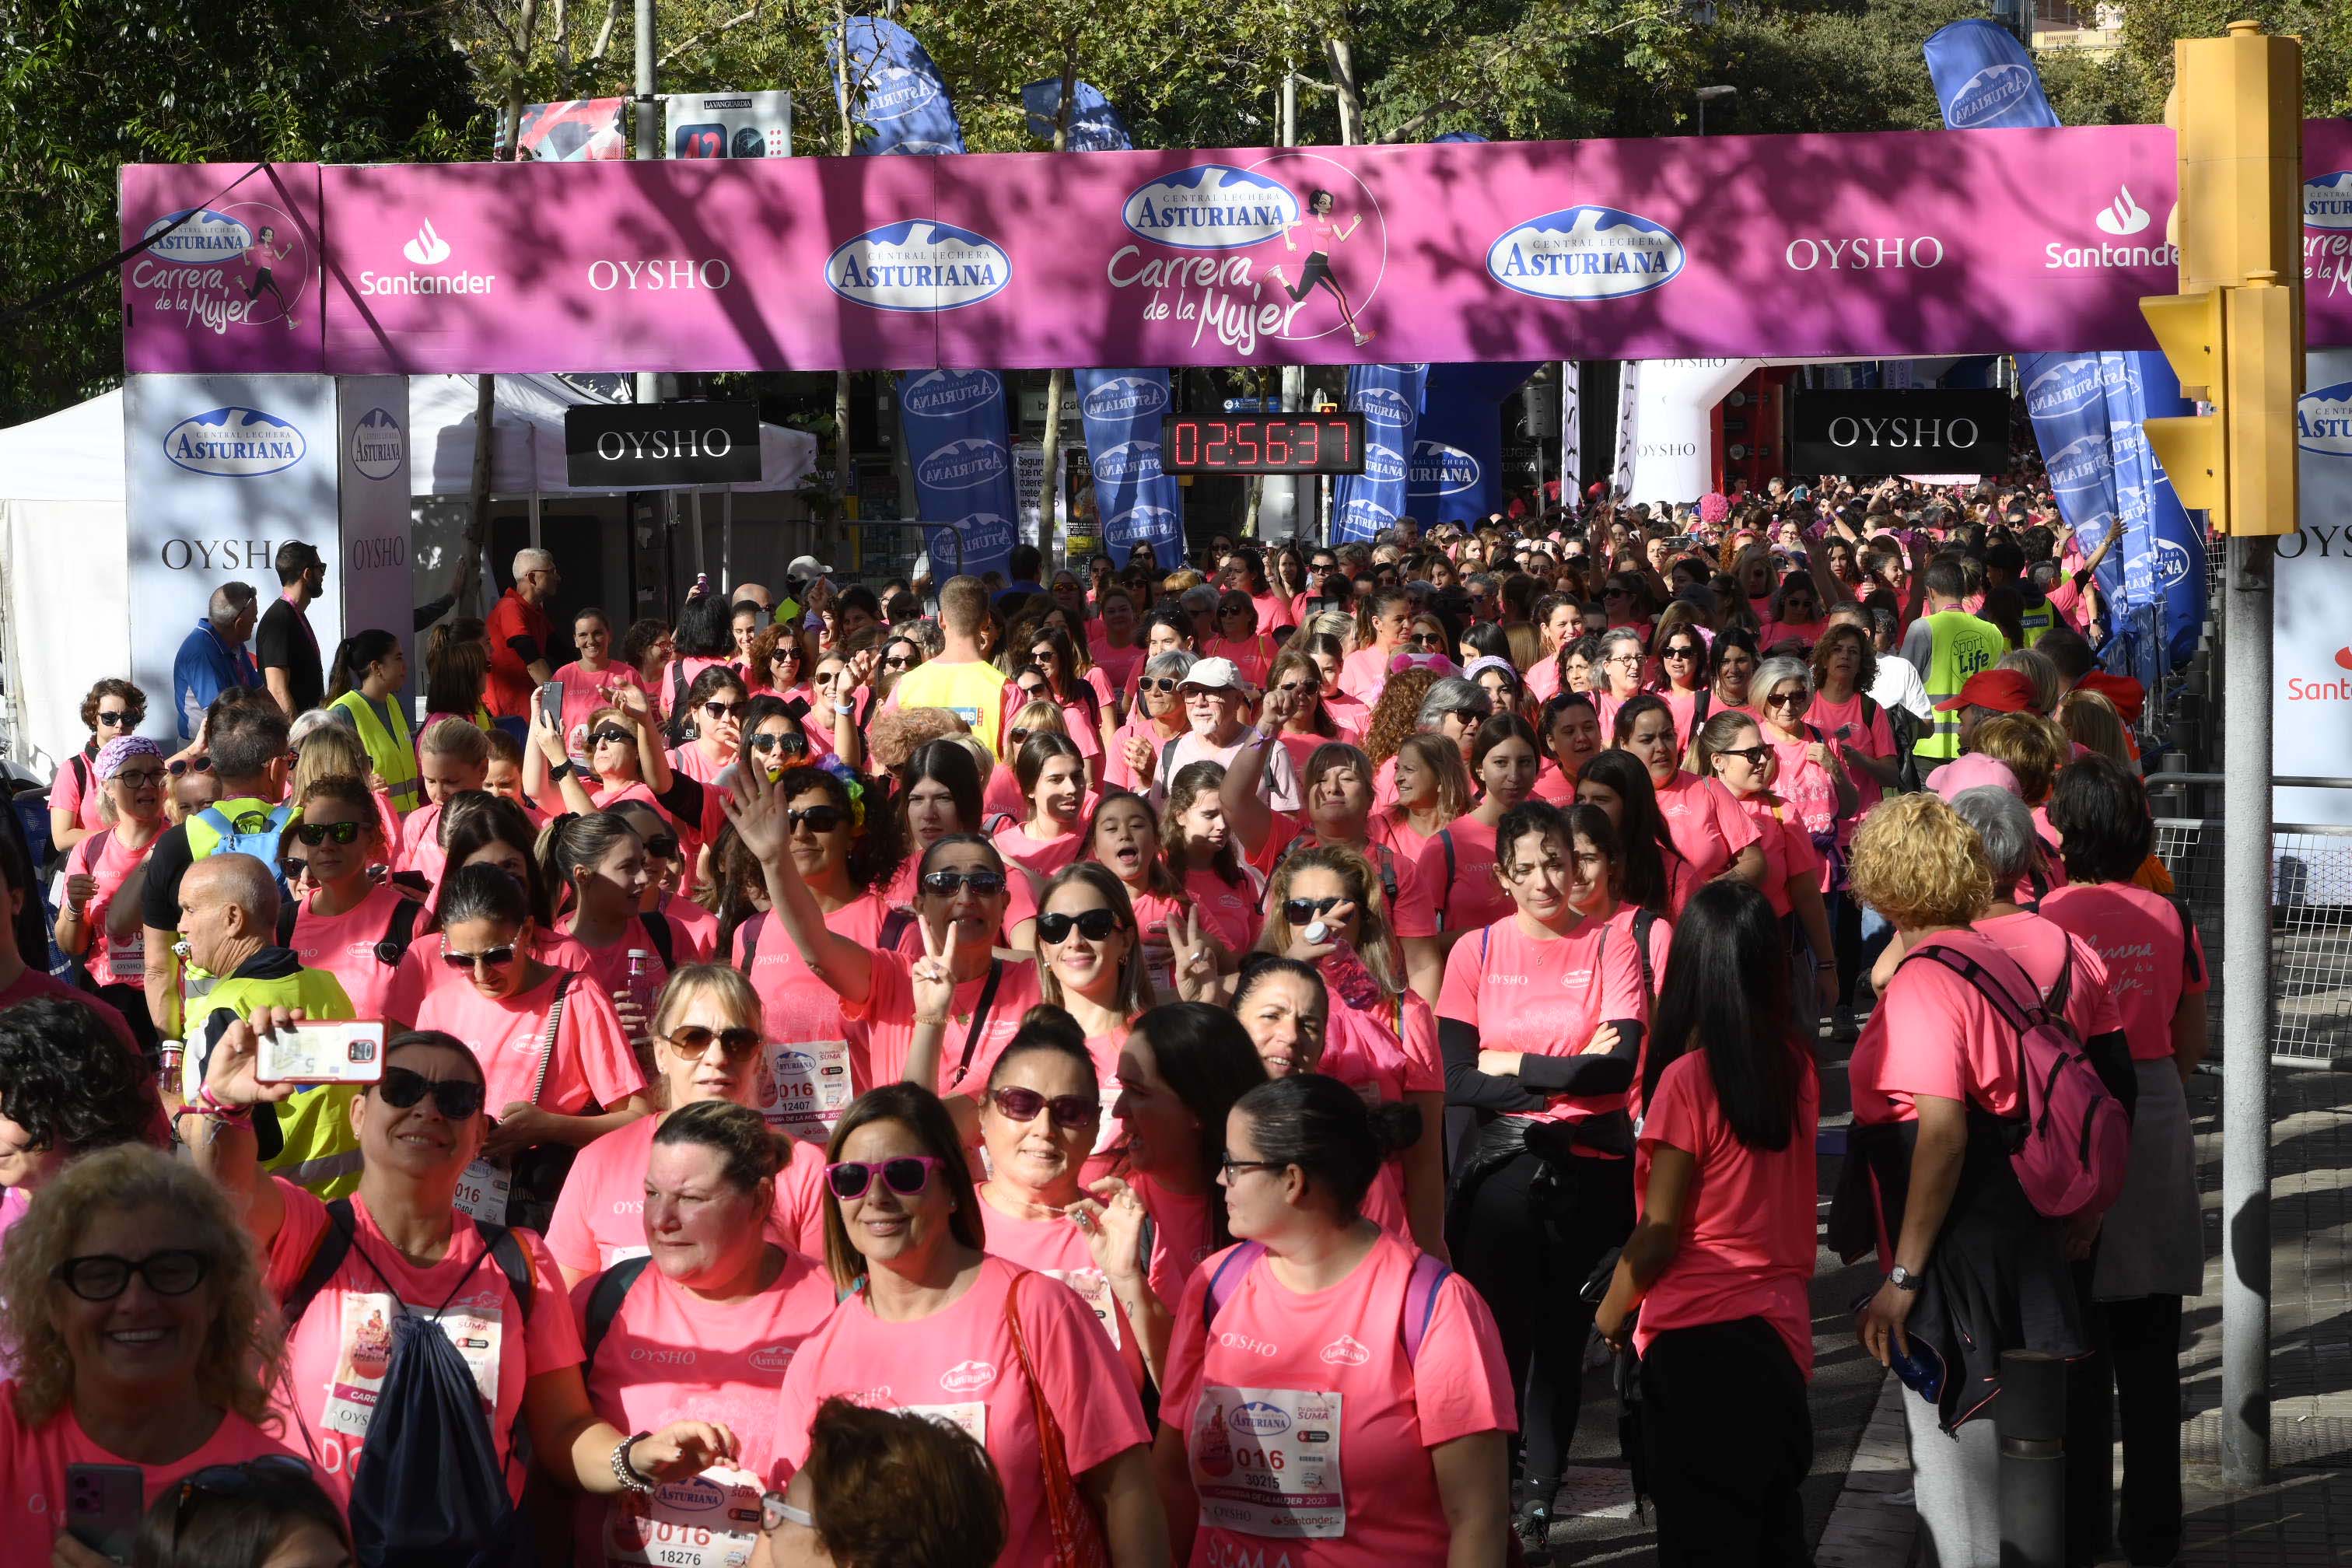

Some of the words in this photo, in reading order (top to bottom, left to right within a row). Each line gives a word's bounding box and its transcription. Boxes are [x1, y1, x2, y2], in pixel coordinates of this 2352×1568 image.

[713, 100, 751, 108] VANGUARDIA
[1163, 194, 1219, 203] CENTRAL
[1223, 192, 1280, 201] LECHERA
[2303, 199, 2352, 215] STUR
[1136, 196, 1285, 229] ASTURIANA
[1532, 238, 1594, 249] CENTRAL
[1600, 236, 1663, 247] LECHERA
[868, 250, 926, 261] CENTRAL
[933, 250, 991, 260] LECHERA
[1502, 242, 1670, 277] ASTURIANA
[1785, 236, 1944, 271] OYSHO
[2045, 241, 2179, 268] Santande
[132, 260, 224, 289] Carrera
[588, 258, 731, 291] OYSHO
[838, 254, 997, 288] ASTURIANA
[1107, 245, 1253, 288] Carrera
[2327, 255, 2352, 299] M
[360, 270, 495, 294] Santander
[156, 291, 172, 310] de
[176, 291, 187, 310] la
[185, 286, 258, 334] Mujer
[1143, 296, 1170, 321] de
[1176, 289, 1195, 320] la
[1192, 282, 1307, 356] Mujer
[1829, 417, 1979, 448] OYSHO
[2298, 409, 2352, 437] ASTU
[175, 433, 296, 460] ASTURIANA
[355, 435, 402, 462] ASTURIANA
[597, 428, 731, 460] OYSHO
[1176, 422, 1349, 465] 02:56:37
[1636, 442, 1696, 458] OYSHO
[1020, 478, 1045, 487] quiere
[161, 539, 304, 570] OYSH
[353, 536, 405, 571] OYSHO
[2020, 616, 2048, 625] OLUNTARIS
[1953, 636, 1984, 657] Sport
[1958, 649, 1990, 674] Life
[2288, 677, 2352, 701] Sant
[1487, 974, 1528, 985] OYSHO
[820, 1052, 842, 1061] SUMA
[779, 1082, 814, 1098] 016
[782, 1101, 810, 1111] 12407
[455, 1182, 481, 1203] 016
[614, 1200, 644, 1214] OYS
[1080, 1293, 1101, 1301] UMA
[458, 1321, 488, 1332] SUMA
[630, 1348, 696, 1365] OYSHO
[752, 1354, 791, 1366] ASTURIA
[351, 1391, 377, 1404] CARR
[340, 1409, 369, 1426] OYS
[1234, 1413, 1286, 1429] ASTURIANA
[1297, 1411, 1329, 1420] SUMA
[1237, 1447, 1285, 1470] 016
[1245, 1473, 1280, 1489] 30215
[658, 1486, 719, 1506] ASTURIANA
[1272, 1496, 1303, 1506] MUJER
[656, 1522, 712, 1546] 016
[660, 1549, 702, 1566] 18276
